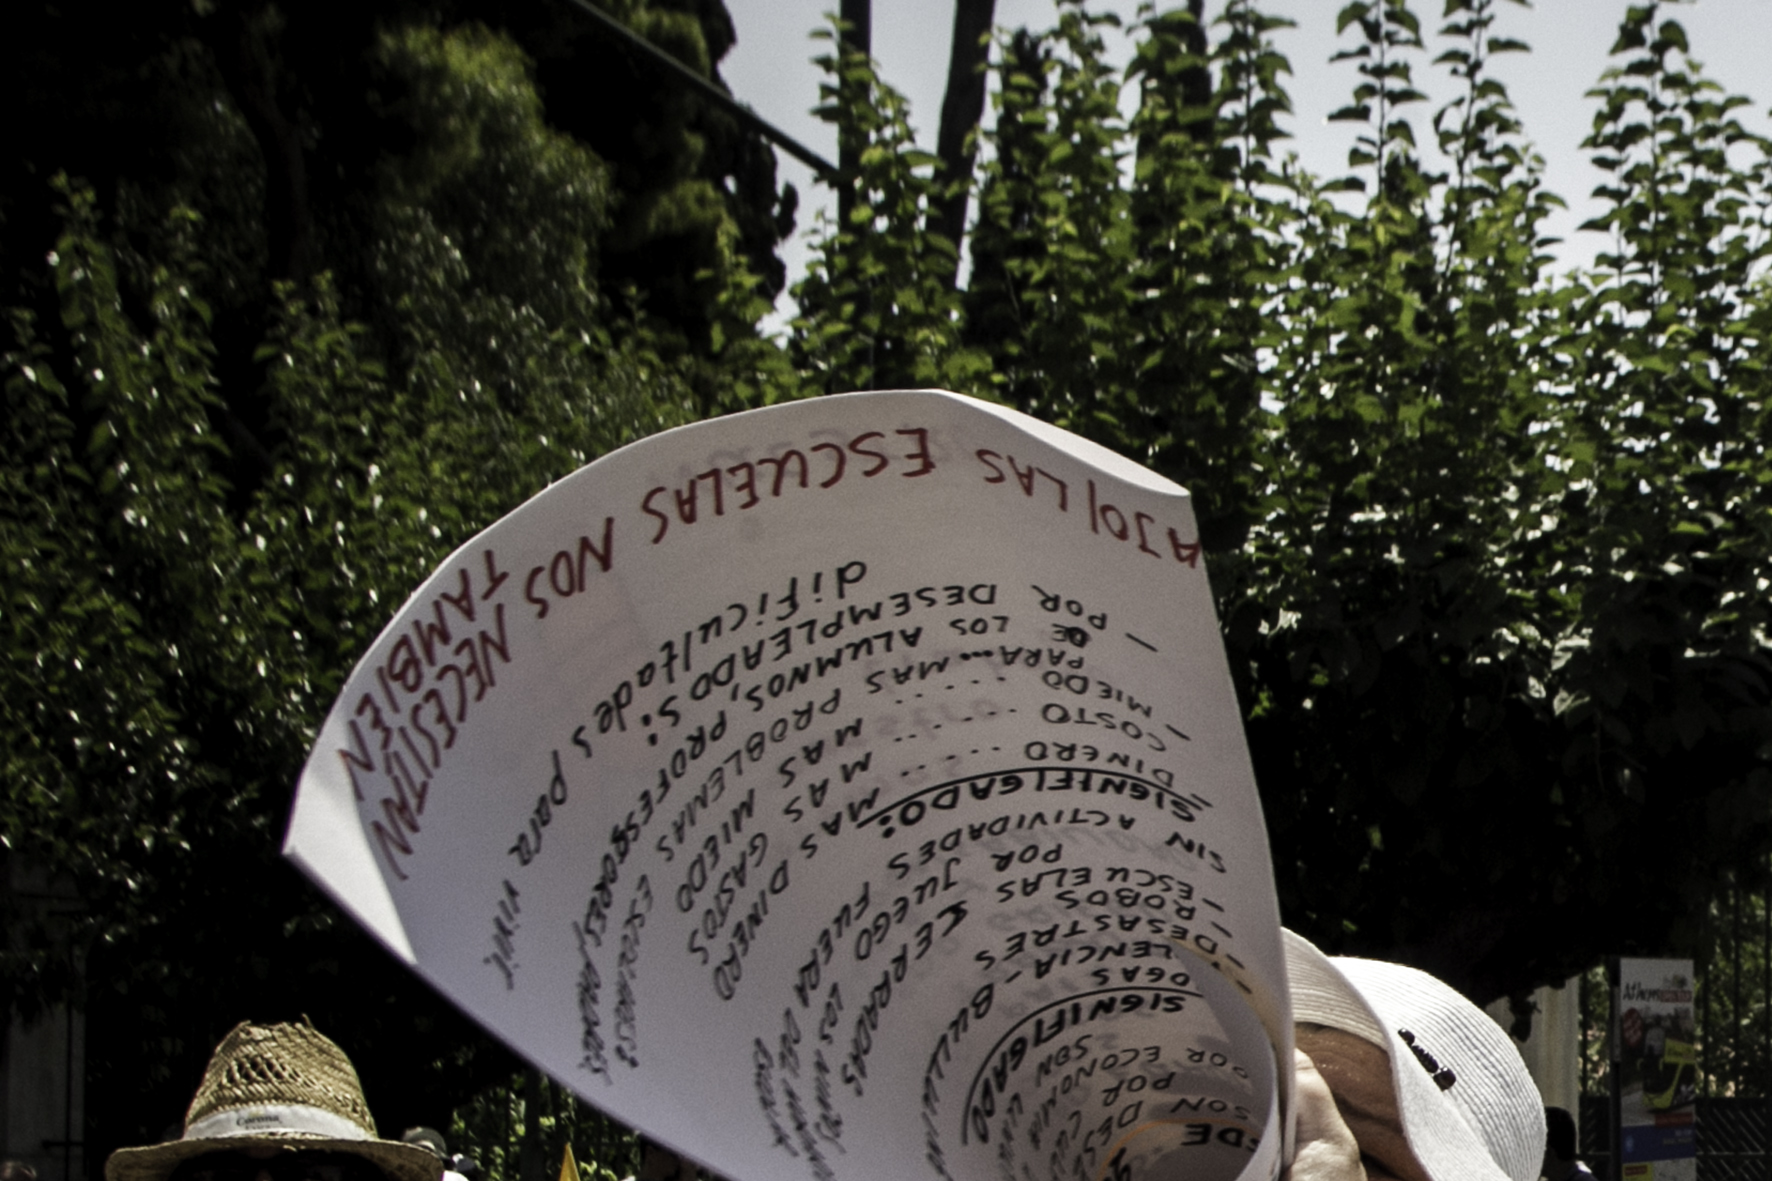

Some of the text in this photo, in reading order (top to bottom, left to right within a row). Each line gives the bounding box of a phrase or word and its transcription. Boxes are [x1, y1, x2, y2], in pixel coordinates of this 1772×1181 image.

[642, 427, 936, 544] ESCUELAS
[976, 449, 1067, 512] LAS
[525, 517, 614, 618] NOS
[951, 615, 1009, 635] LOS
[1031, 585, 1107, 630] POR
[641, 584, 997, 746] DESEMPLEADOS:
[866, 657, 949, 694] MAS
[371, 603, 511, 881] NECESITAN
[657, 688, 841, 862] PROBLEMAS
[677, 671, 1153, 912] MIEDO MAS MIEDO
[508, 750, 568, 866] para
[688, 703, 1167, 965] COSTO MAS GASTOS
[713, 741, 1175, 1001] DINERO MAS DINERO
[888, 808, 1136, 880] ACTIVIDADES
[991, 844, 1063, 873] POR
[1164, 832, 1227, 874] SIN
[854, 857, 961, 961] JUEGO
[997, 866, 1195, 904] ESCUELAS
[1056, 887, 1196, 922] ROBOS
[974, 914, 1219, 971] DESASTRES
[1035, 1034, 1093, 1088] SON
[1102, 1071, 1177, 1107] POR
[1170, 1097, 1250, 1121] SON
